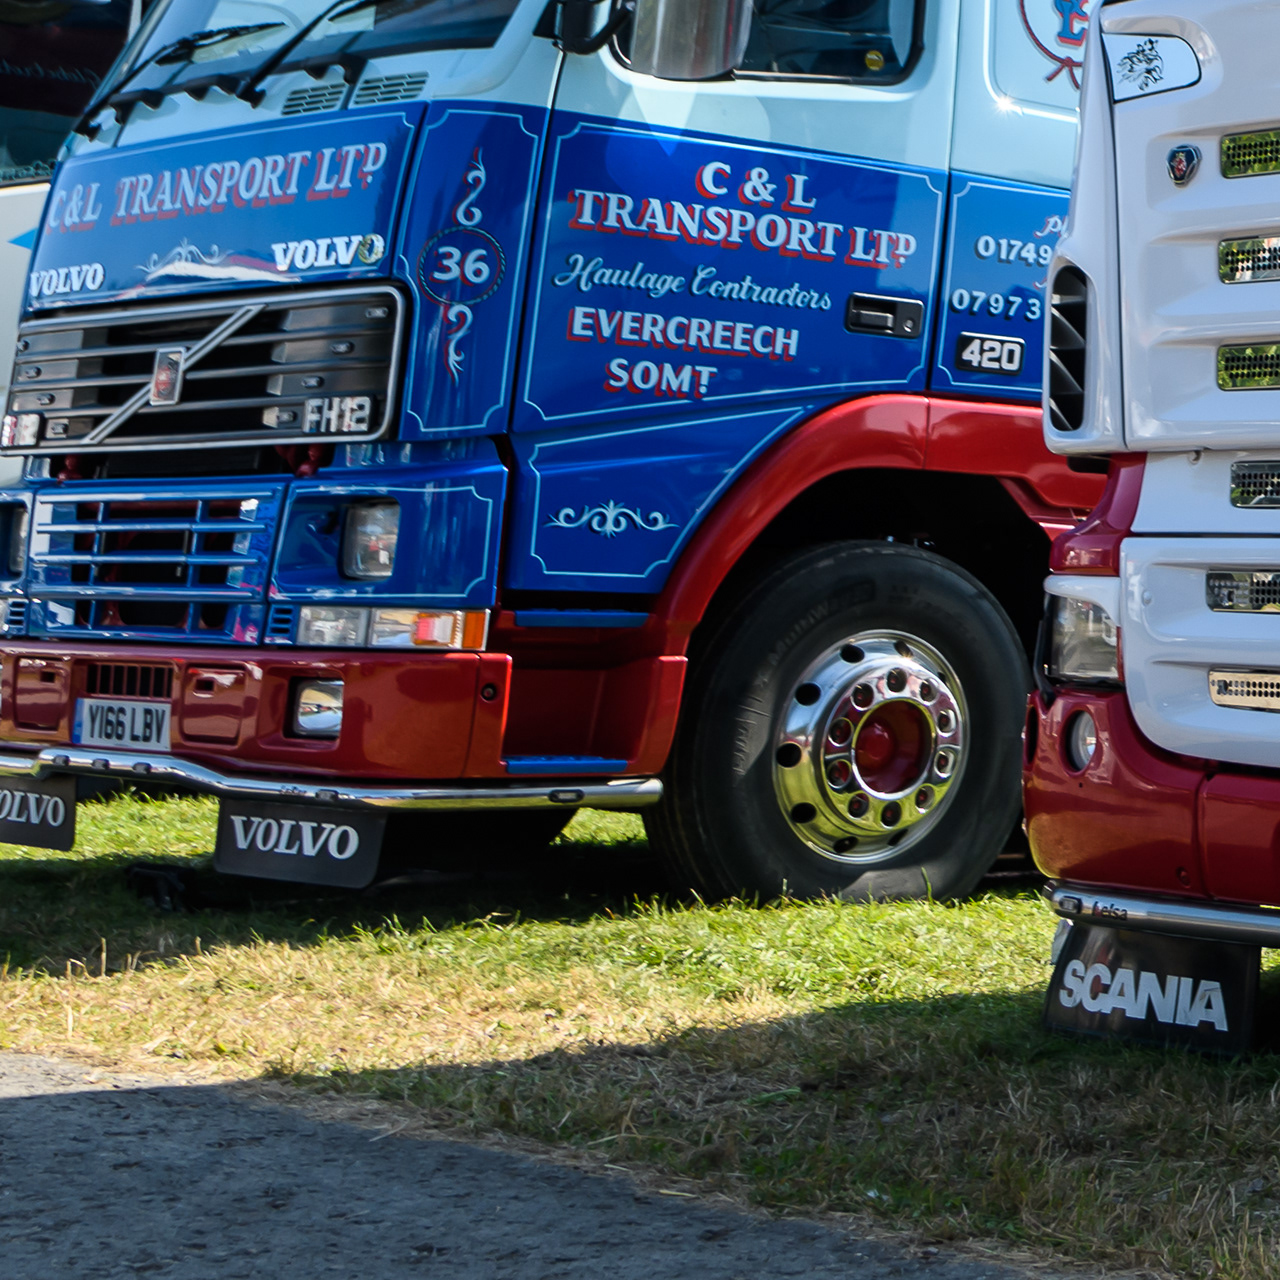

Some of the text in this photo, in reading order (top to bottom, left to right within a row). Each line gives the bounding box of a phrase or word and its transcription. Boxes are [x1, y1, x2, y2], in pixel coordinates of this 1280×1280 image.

[111, 150, 311, 226] TRANSPORT
[696, 161, 816, 214] C & L
[568, 188, 844, 262] TRANSPORT
[272, 233, 385, 273] VOLVO
[431, 246, 491, 285] 36
[29, 263, 106, 298] VOLVO
[554, 253, 832, 312] Haulage Contractors
[951, 288, 1041, 320] 07973
[567, 305, 801, 362] EVERCREECH
[961, 337, 1022, 372] 420
[304, 396, 371, 433] FH12
[88, 704, 166, 743] Y166 LBV
[0, 789, 66, 828] OLVO
[230, 815, 360, 860] VOLVO
[1059, 959, 1229, 1033] SCANIA
